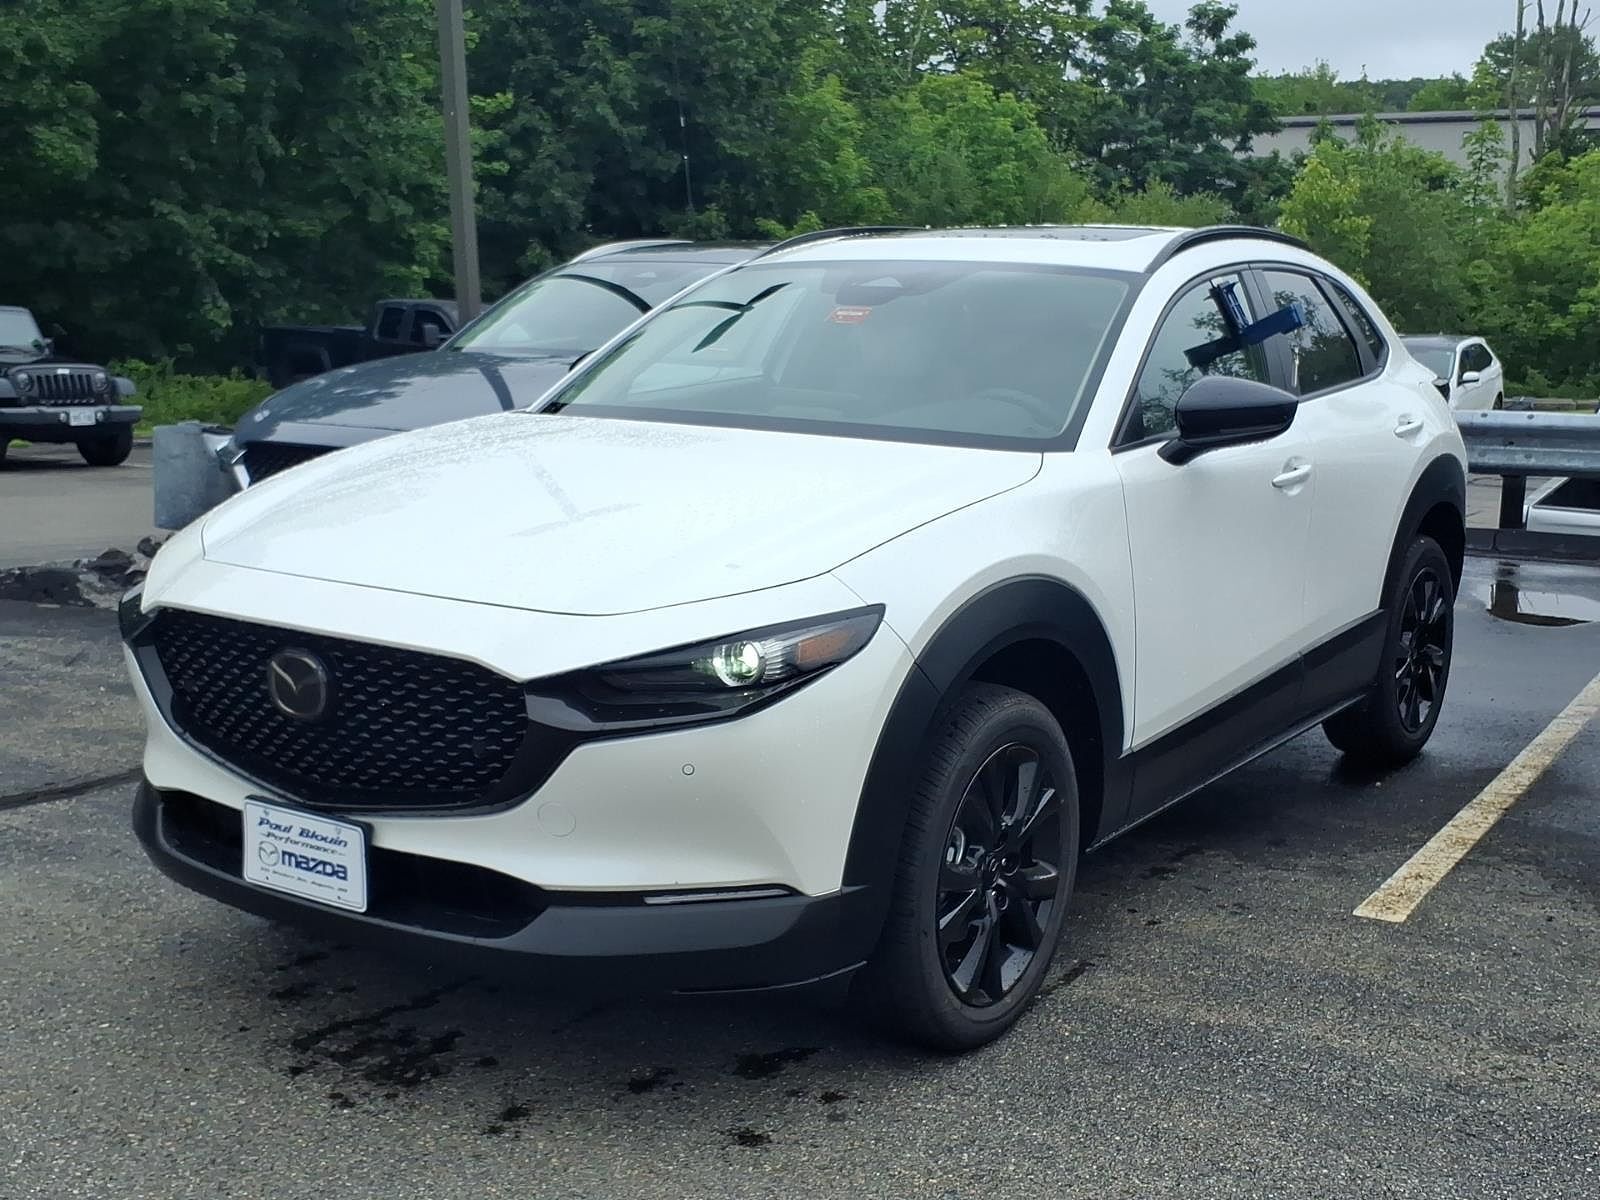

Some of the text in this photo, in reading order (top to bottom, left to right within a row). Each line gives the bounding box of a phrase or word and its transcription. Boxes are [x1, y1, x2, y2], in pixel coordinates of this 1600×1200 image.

[258, 817, 347, 848] Paul Blouin
[265, 832, 340, 855] Performance
